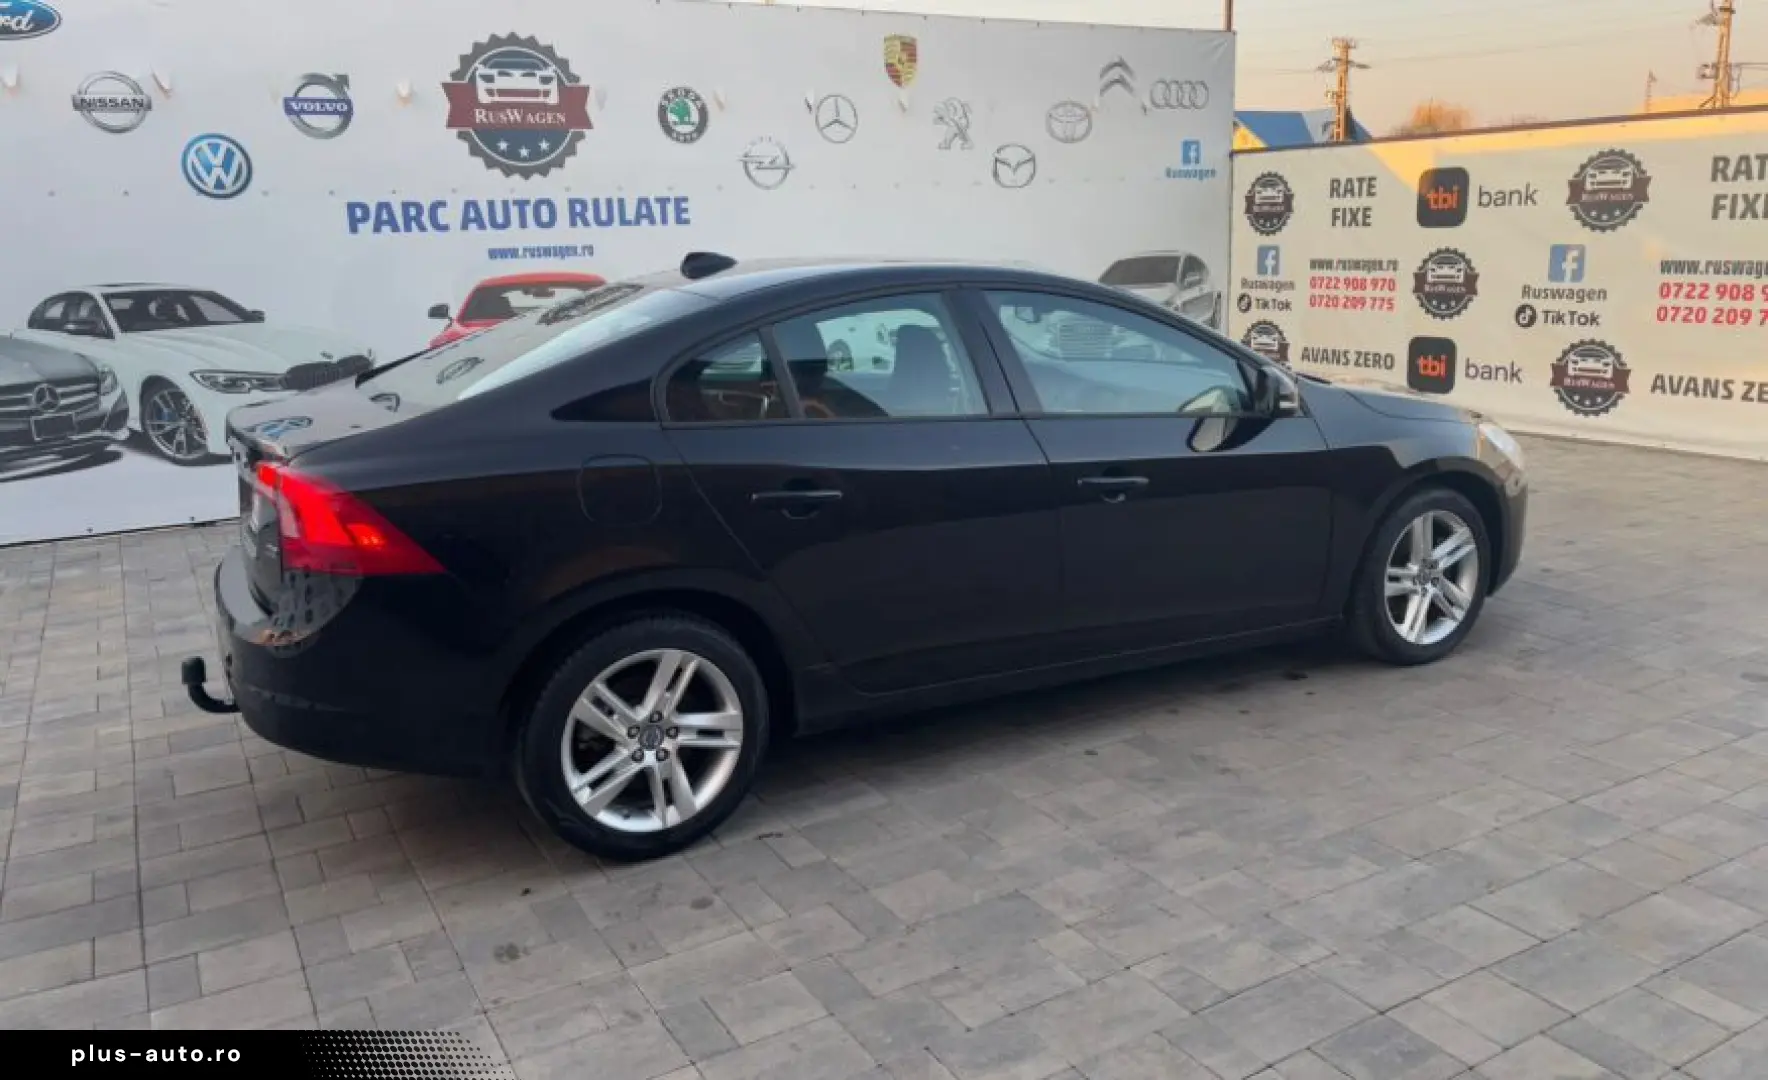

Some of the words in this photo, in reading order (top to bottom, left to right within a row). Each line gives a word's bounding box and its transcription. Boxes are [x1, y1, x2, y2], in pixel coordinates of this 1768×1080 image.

[80, 97, 144, 108] NISSAN
[290, 102, 348, 112] VOLVO
[1330, 177, 1377, 198] RATE
[1426, 185, 1458, 210] tbi
[1477, 182, 1538, 208] bank
[347, 200, 450, 234] PARC
[460, 199, 558, 231] AUTO
[568, 196, 691, 227] RULATE
[1331, 207, 1372, 227] FIXE
[1370, 278, 1396, 292] 970
[1521, 284, 1607, 303] Ruswagen
[1660, 282, 1709, 299] 0722
[1715, 284, 1755, 301] 908
[1369, 296, 1395, 312] 775
[1541, 310, 1601, 326] TikTok
[1657, 306, 1706, 323] 0720
[1712, 308, 1752, 325] 209
[1301, 346, 1350, 366] AVANS
[1354, 350, 1396, 370] ZERO
[1418, 355, 1447, 378] tbi
[1464, 357, 1523, 384] bank
[1650, 373, 1735, 400] AVANS
